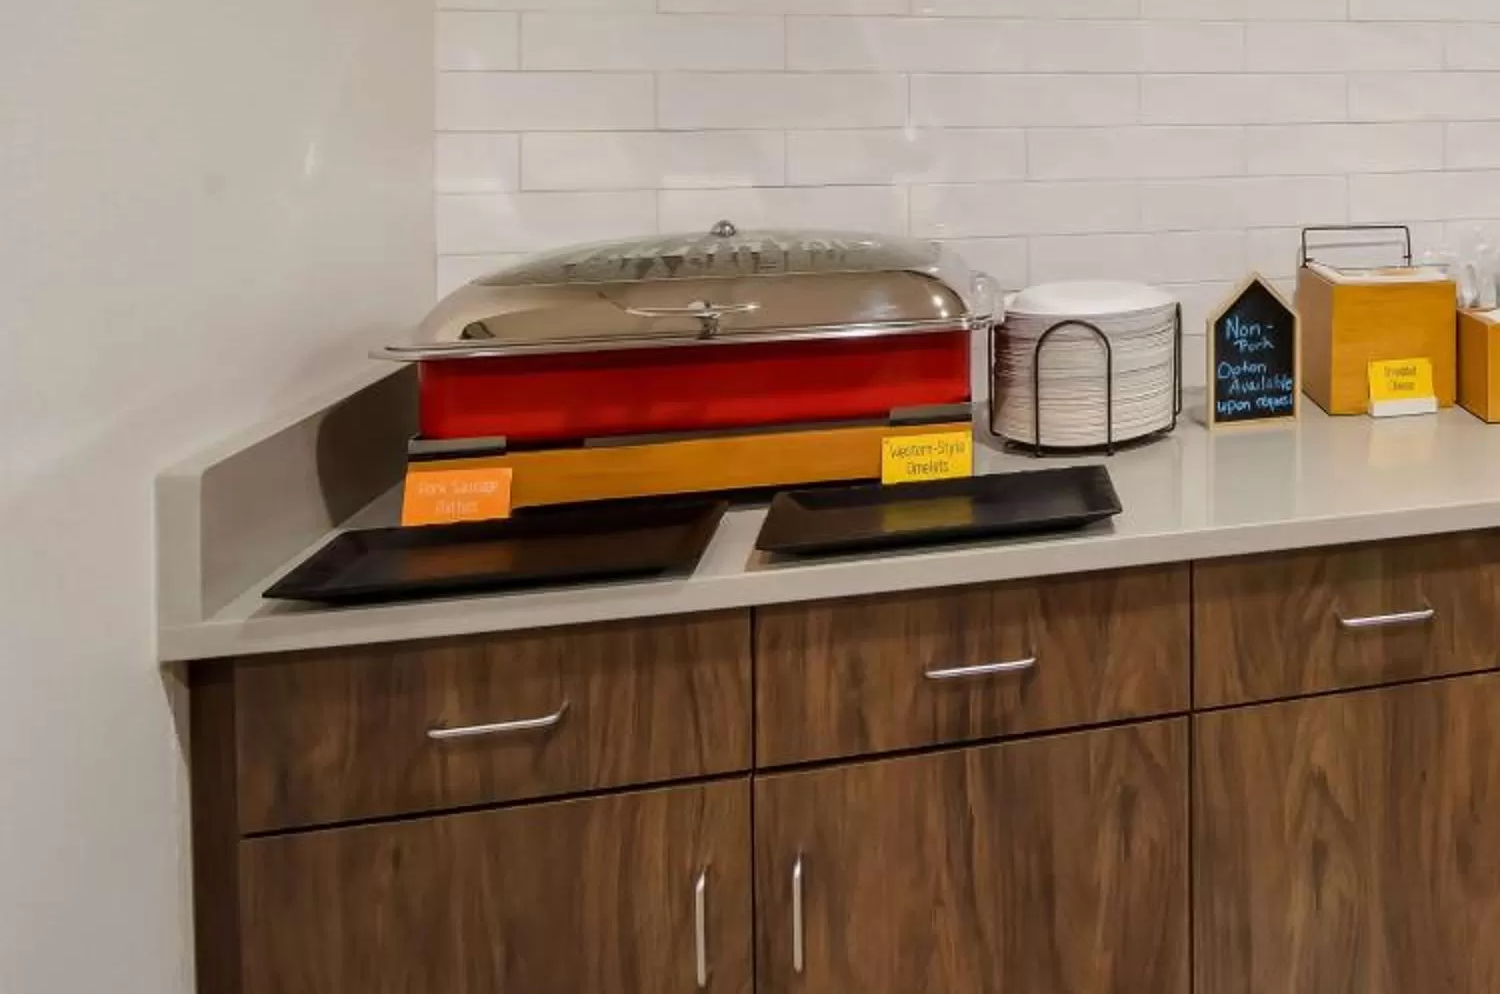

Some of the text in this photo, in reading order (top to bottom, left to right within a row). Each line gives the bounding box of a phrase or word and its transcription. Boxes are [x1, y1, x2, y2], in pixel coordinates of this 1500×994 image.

[1233, 337, 1275, 353] Pork
[1229, 374, 1293, 395] Available
[1217, 399, 1251, 415] upon
